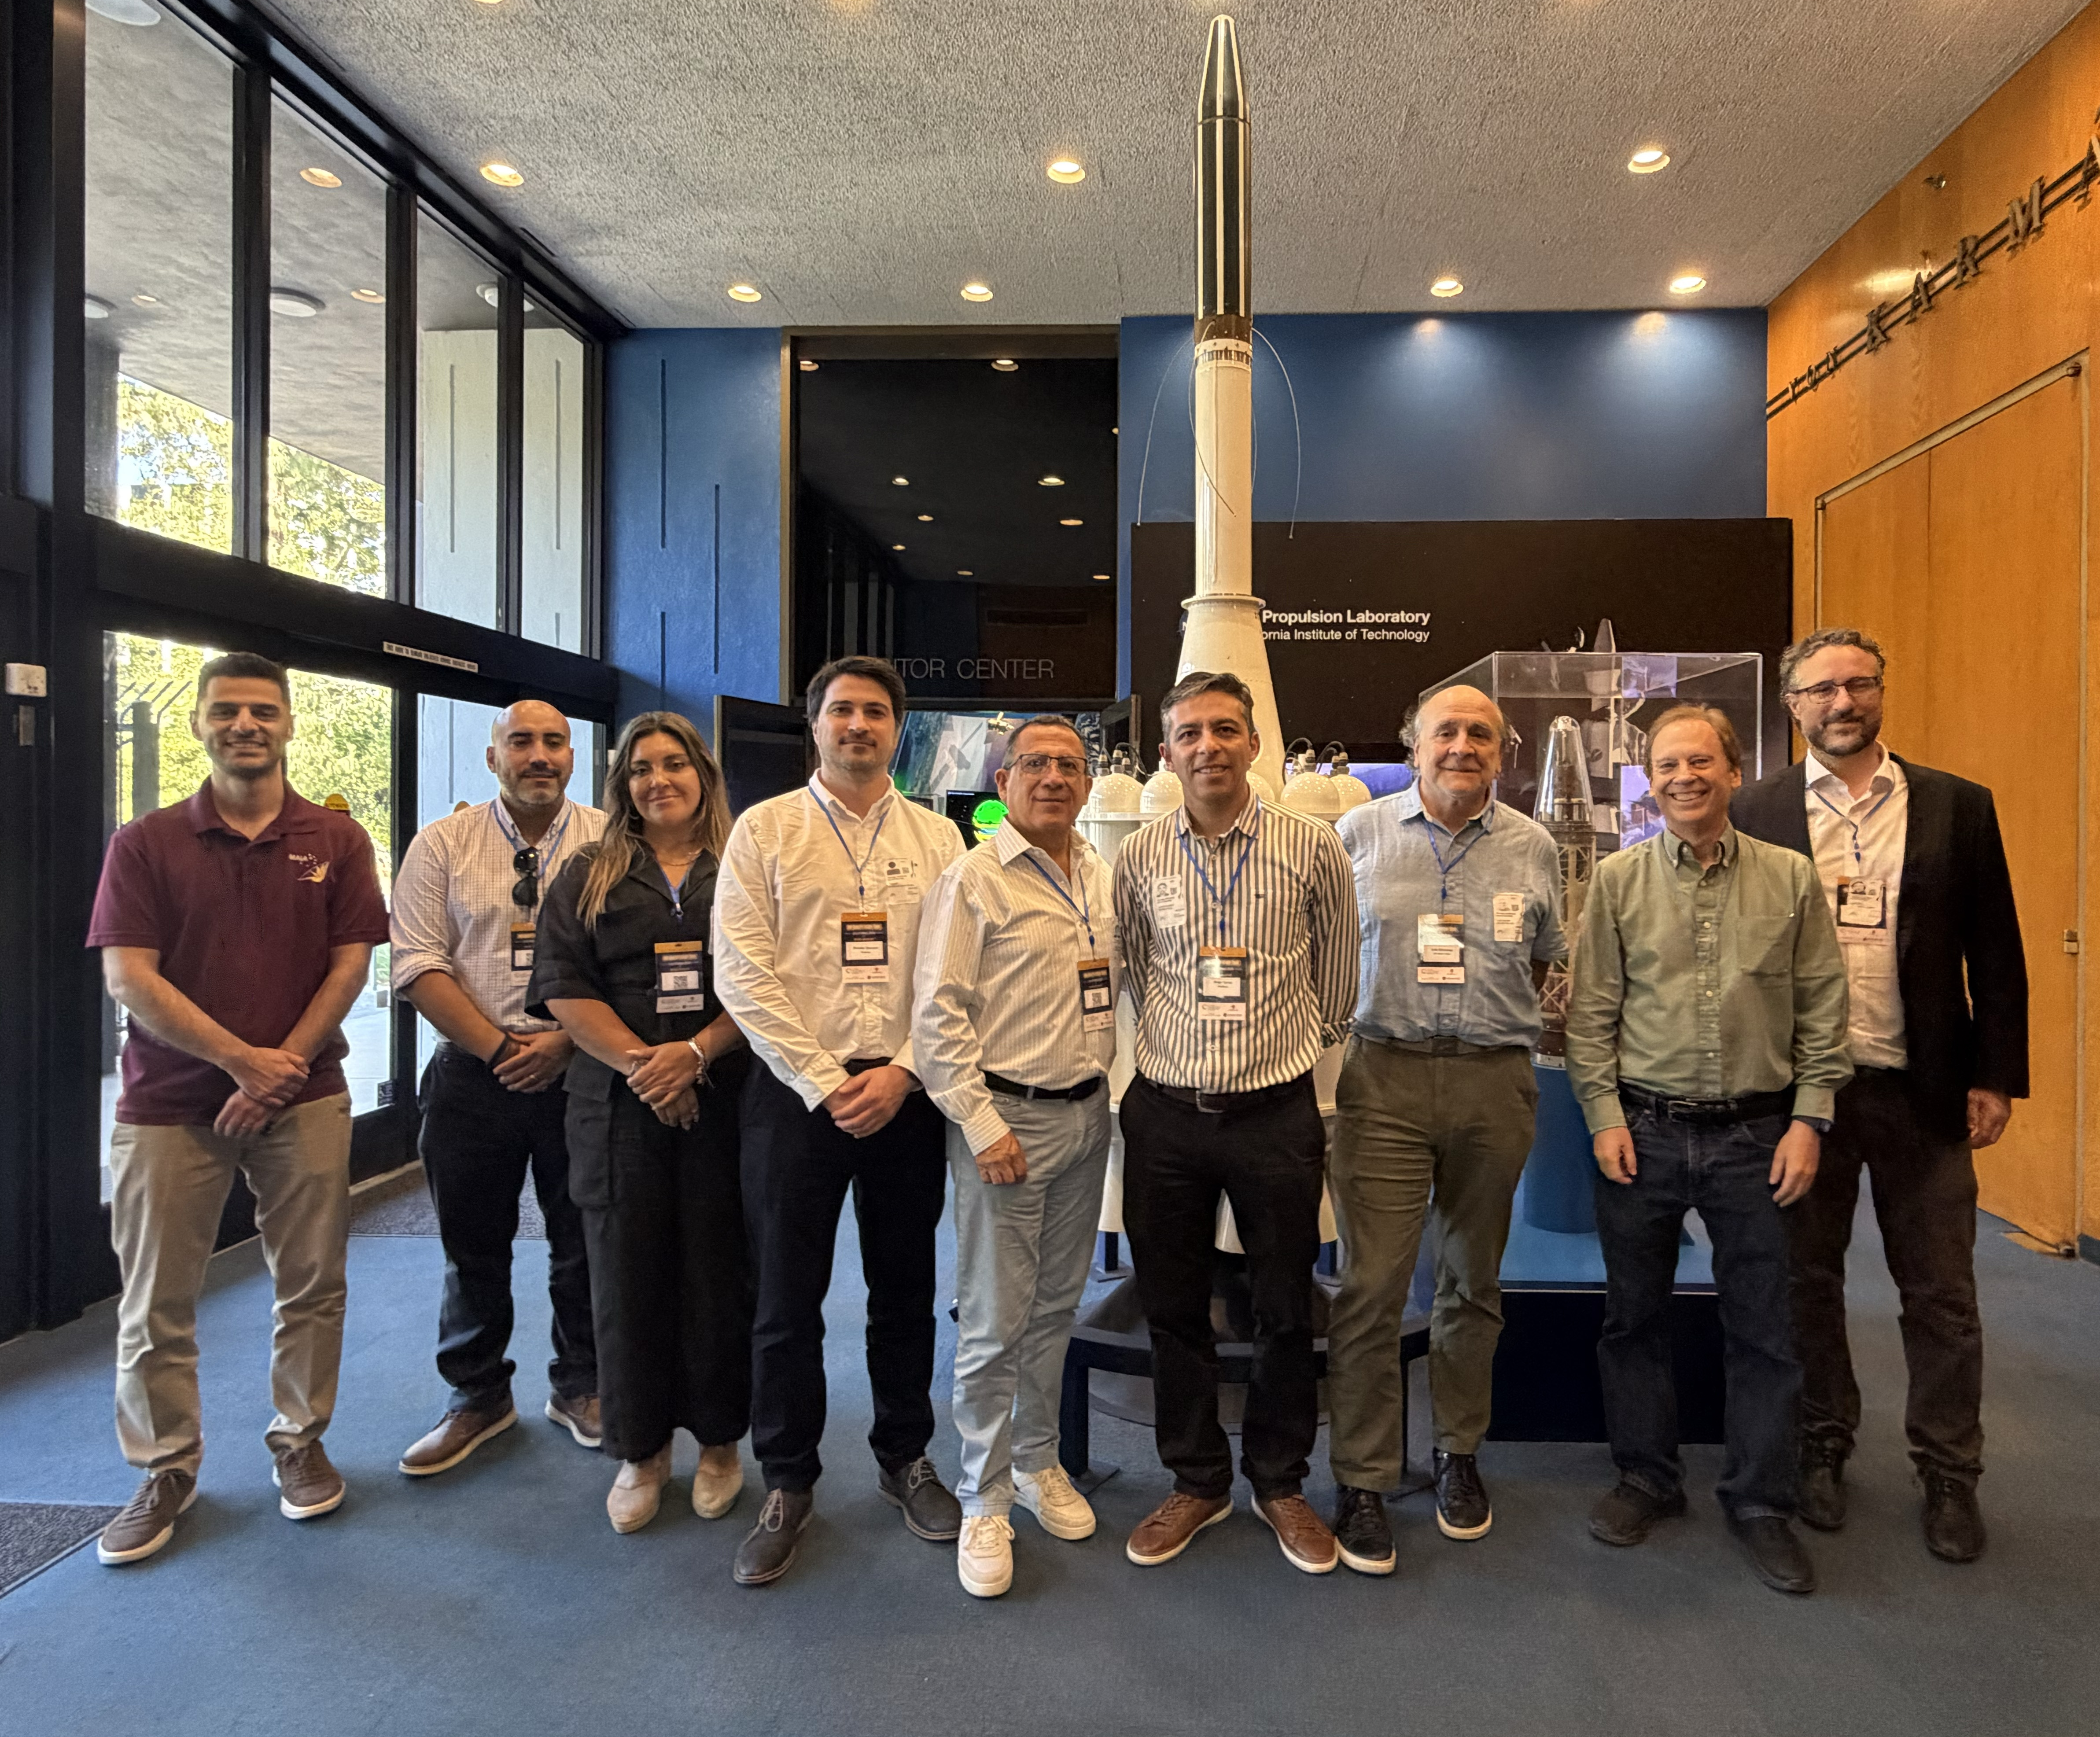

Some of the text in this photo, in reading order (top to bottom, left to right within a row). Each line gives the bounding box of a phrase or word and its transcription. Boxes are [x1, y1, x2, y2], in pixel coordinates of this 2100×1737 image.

[1262, 609, 1431, 626] Propulsion Laboratory
[1294, 628, 1342, 640] Institute
[1345, 628, 1357, 640] of
[1360, 628, 1430, 643] Technology
[957, 658, 1055, 680] CENTER
